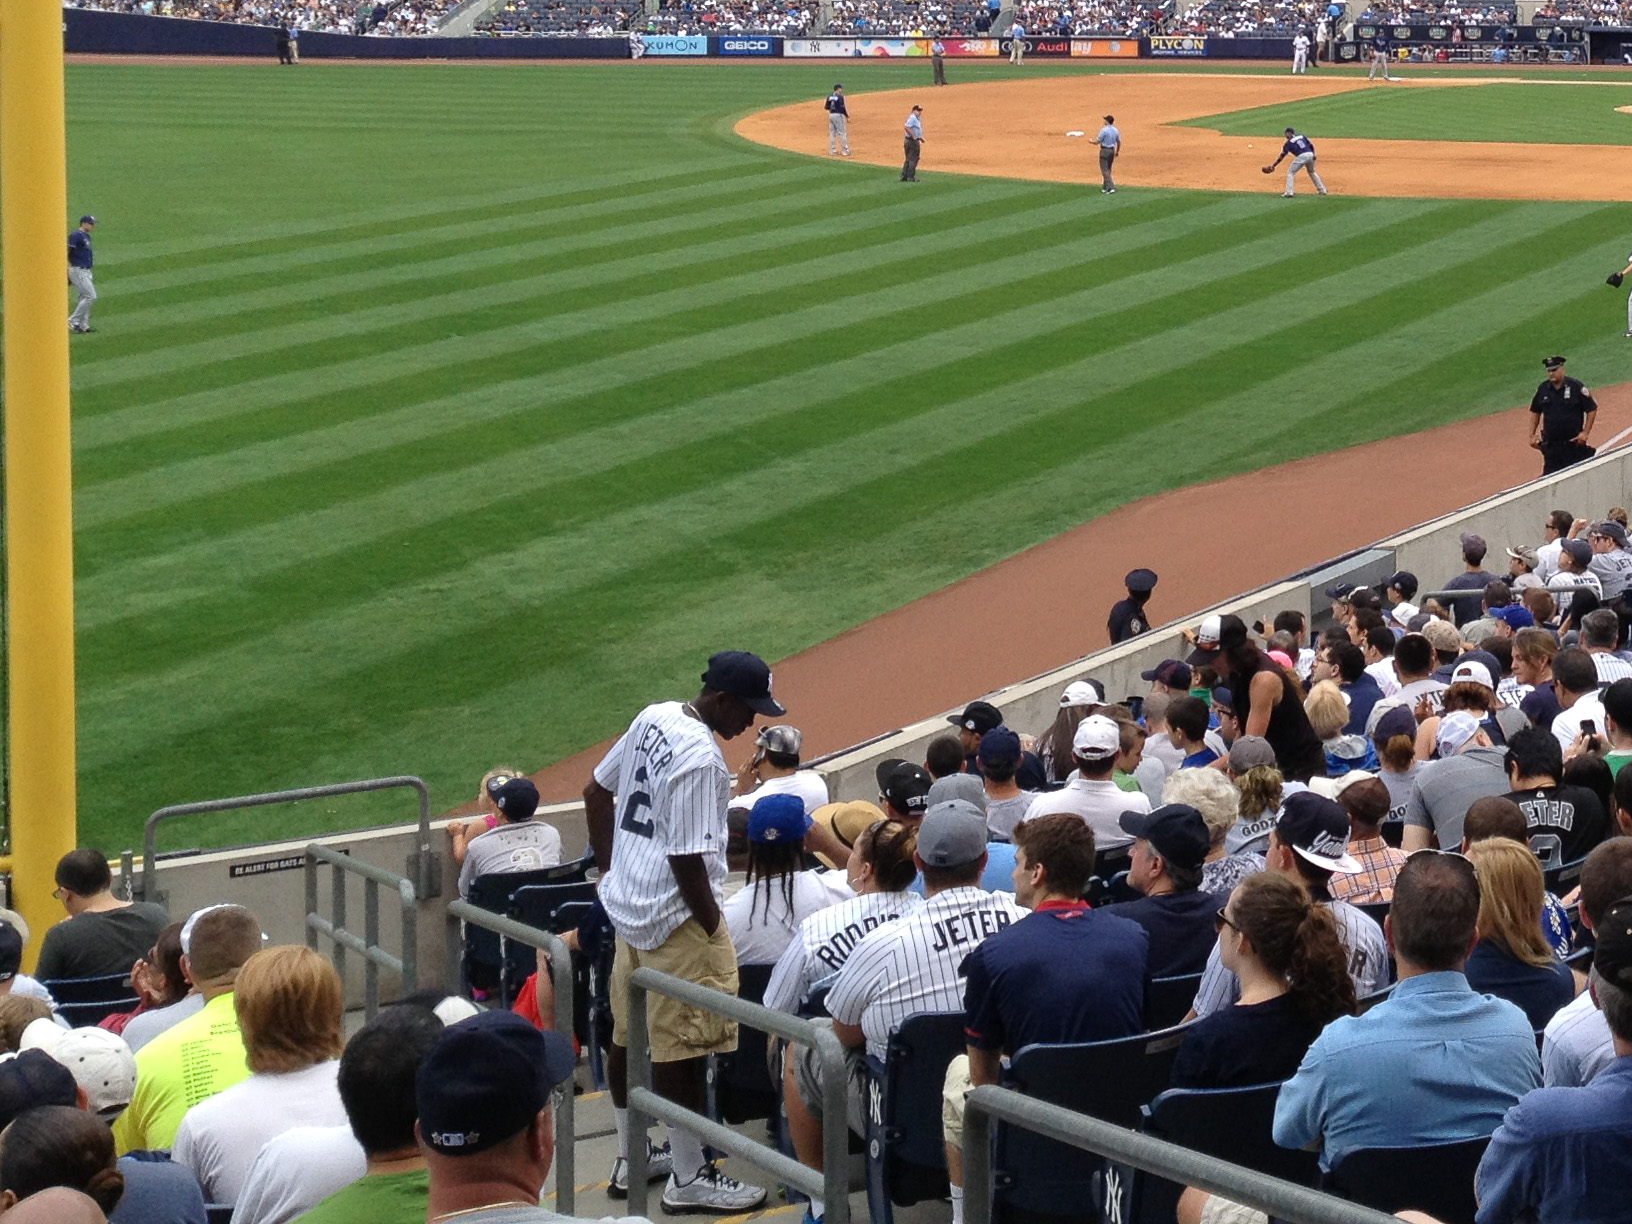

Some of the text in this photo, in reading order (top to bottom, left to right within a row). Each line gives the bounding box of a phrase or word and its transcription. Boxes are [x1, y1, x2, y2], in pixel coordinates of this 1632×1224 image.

[646, 39, 697, 51] KUMON
[724, 41, 769, 50] GEICO
[1036, 42, 1068, 51] Audi
[1150, 39, 1204, 50] PLYCON
[635, 724, 673, 777] JETER
[620, 765, 655, 839] 2
[1519, 799, 1575, 831] ETER
[266, 861, 279, 870] FOR
[932, 910, 1011, 953] JETER
